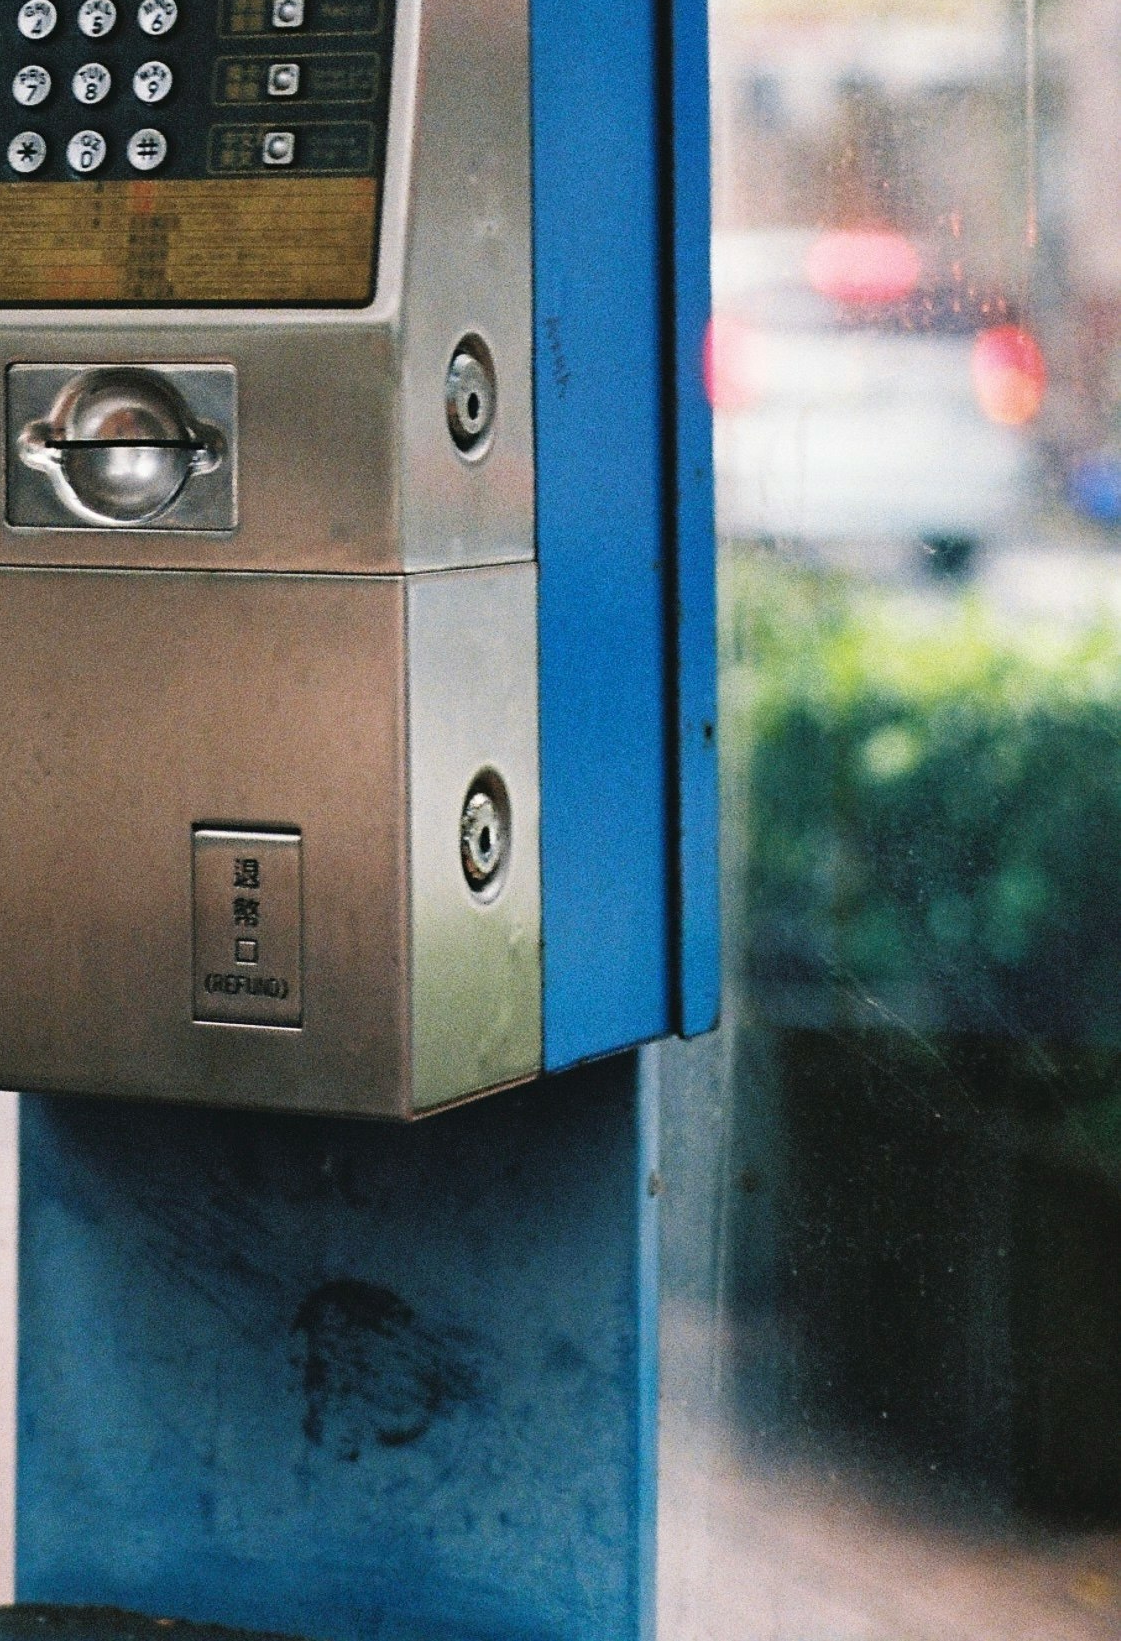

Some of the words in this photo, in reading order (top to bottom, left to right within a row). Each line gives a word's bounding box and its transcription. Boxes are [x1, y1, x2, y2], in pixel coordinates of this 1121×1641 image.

[31, 18, 42, 34] 4
[91, 16, 103, 34] 5
[151, 13, 163, 32] 6
[26, 84, 38, 102] 7
[85, 82, 97, 100] 8
[148, 80, 159, 99] 9
[136, 137, 159, 160] #
[81, 150, 92, 169] 0
[204, 972, 289, 999] (REFUND)
